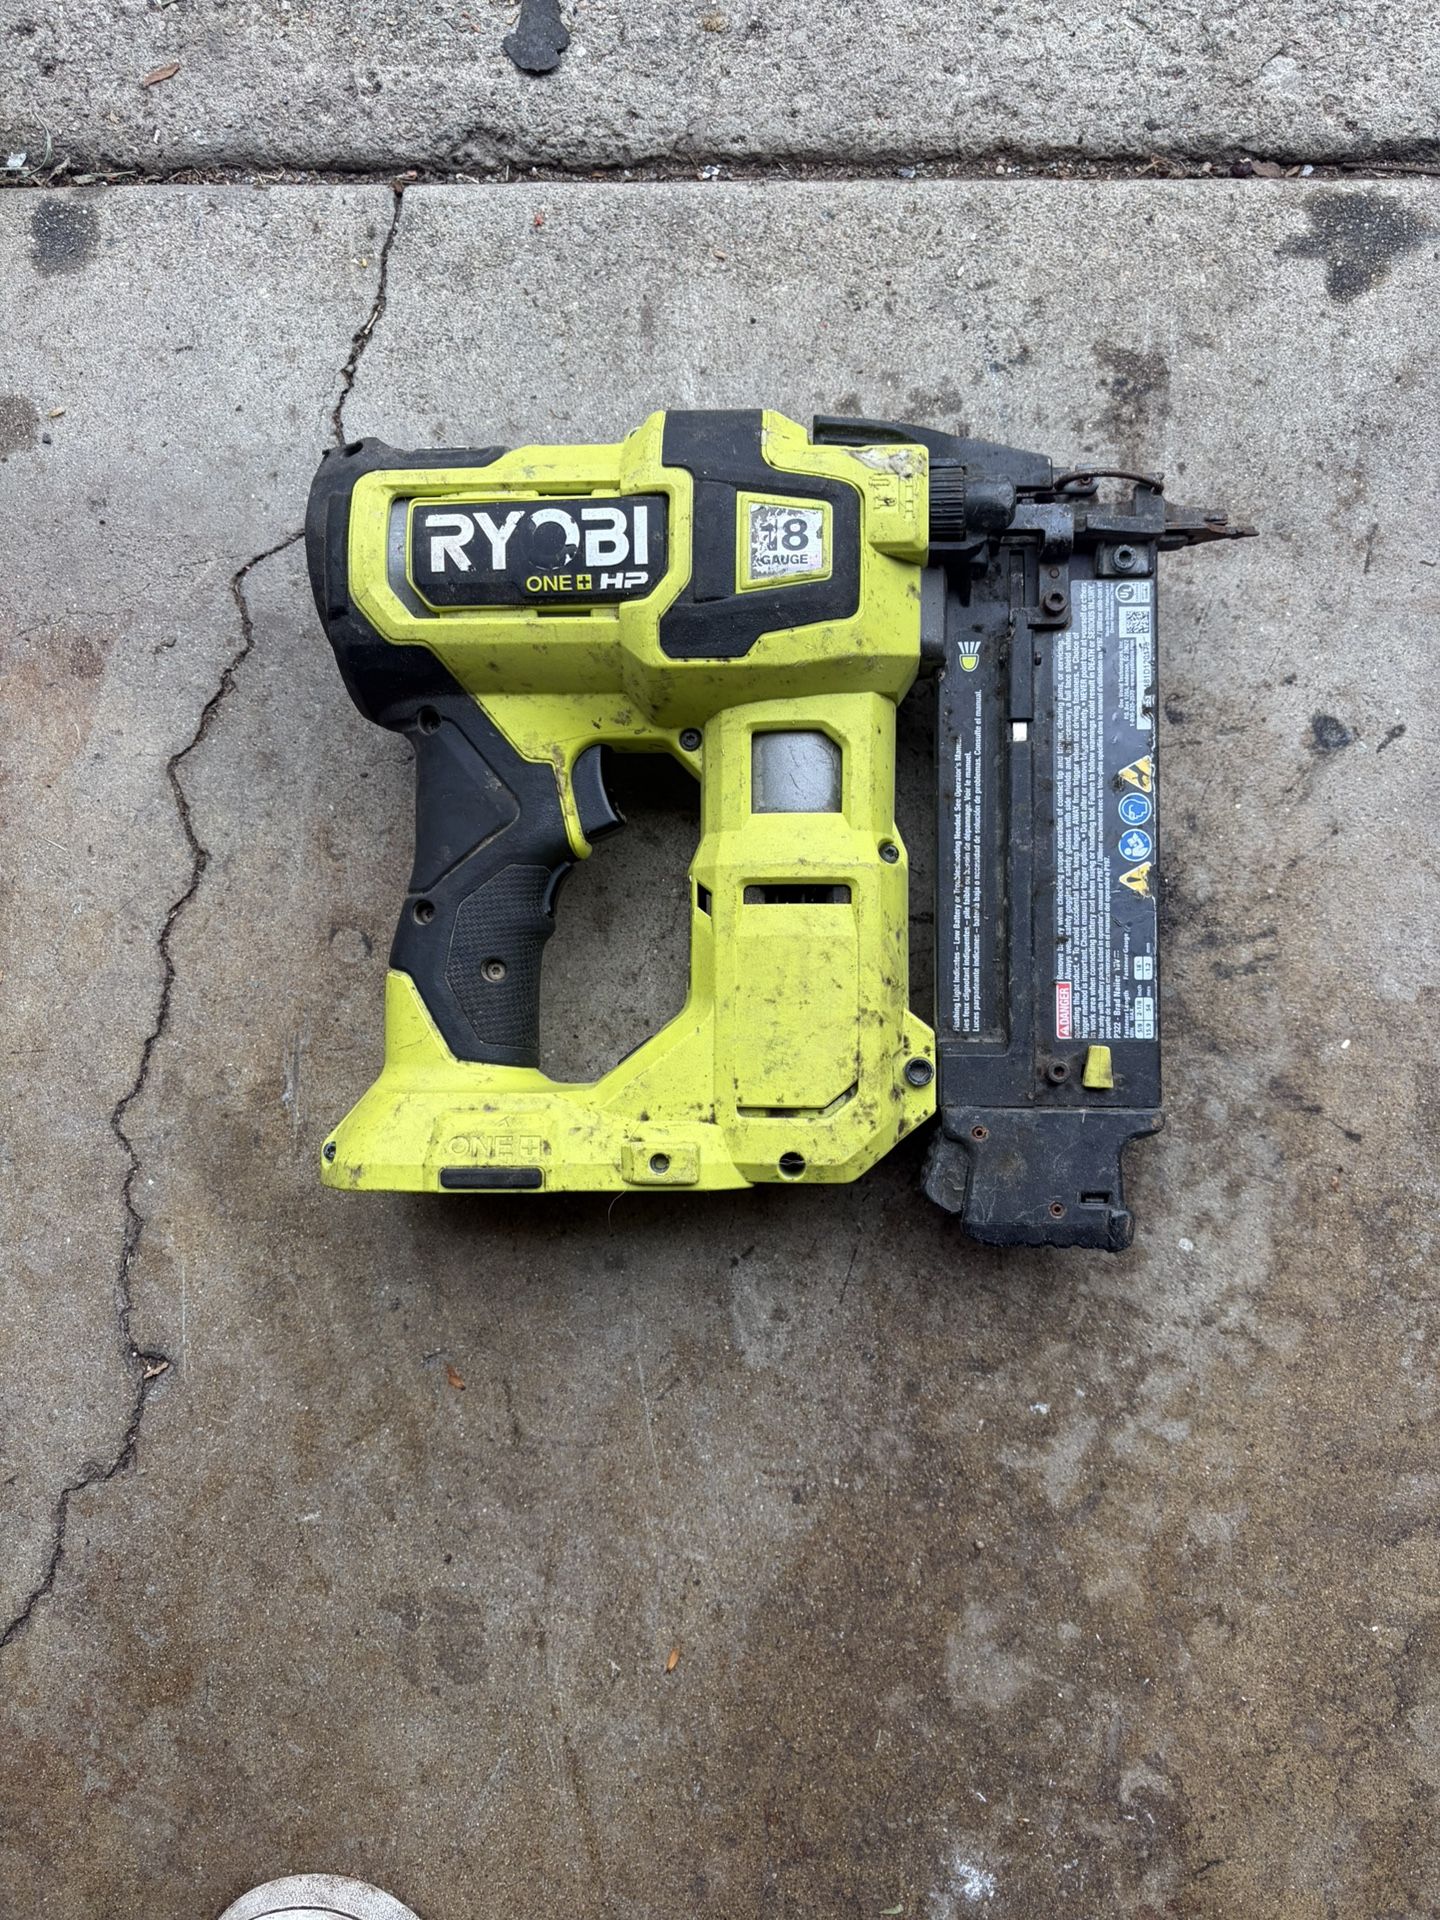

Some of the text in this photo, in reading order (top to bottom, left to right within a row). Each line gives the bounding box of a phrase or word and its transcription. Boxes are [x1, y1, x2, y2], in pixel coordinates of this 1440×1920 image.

[760, 518, 808, 551] 18
[762, 554, 808, 565] GAUGE
[600, 571, 648, 590] HP
[974, 757, 982, 794] problemas.
[974, 795, 981, 804] de
[974, 835, 980, 844] de
[965, 876, 970, 885] ou
[973, 887, 981, 901] baja
[1060, 988, 1069, 1025] DANGER
